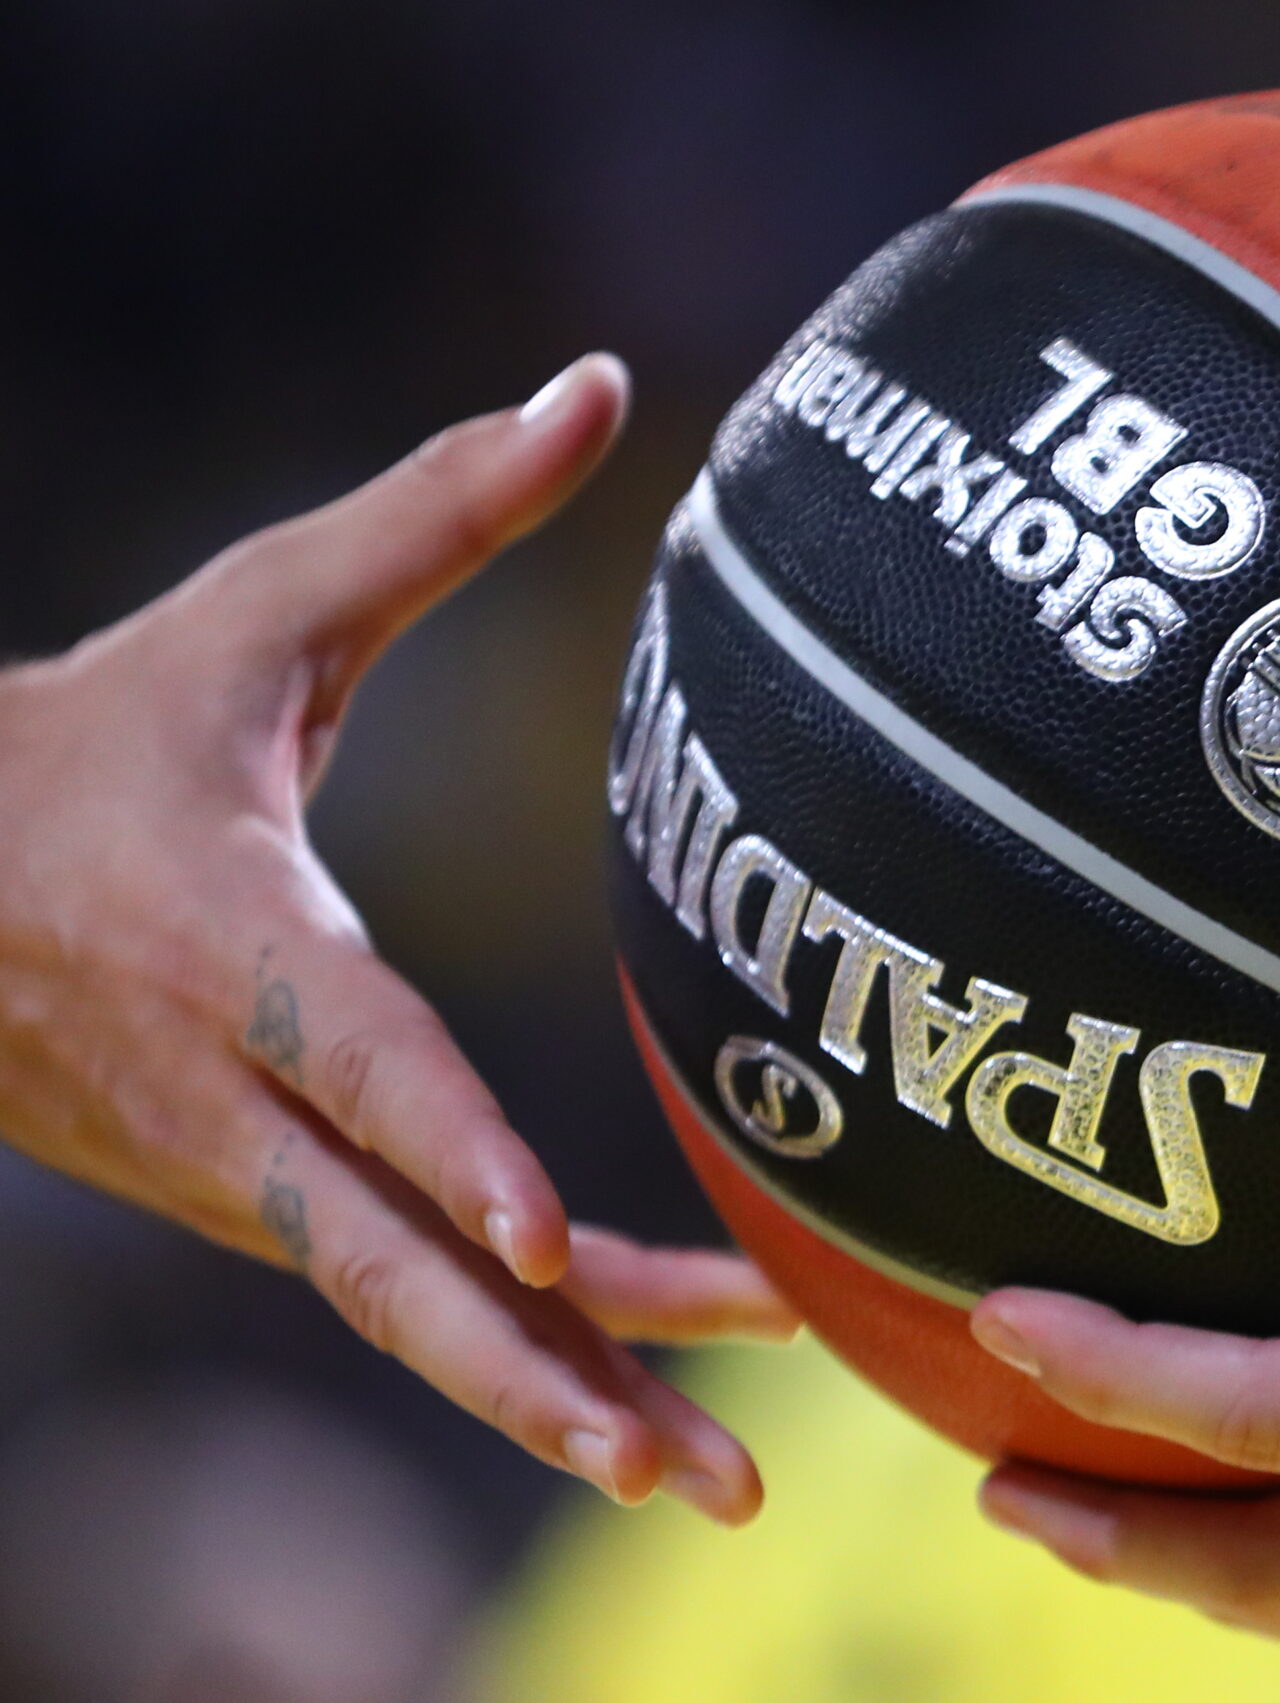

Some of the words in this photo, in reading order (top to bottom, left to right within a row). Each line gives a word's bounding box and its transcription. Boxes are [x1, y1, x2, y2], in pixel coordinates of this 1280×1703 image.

[772, 338, 1190, 683] Stoiximan
[1008, 336, 1267, 581] GBL
[607, 580, 1267, 1246] SPALDING
